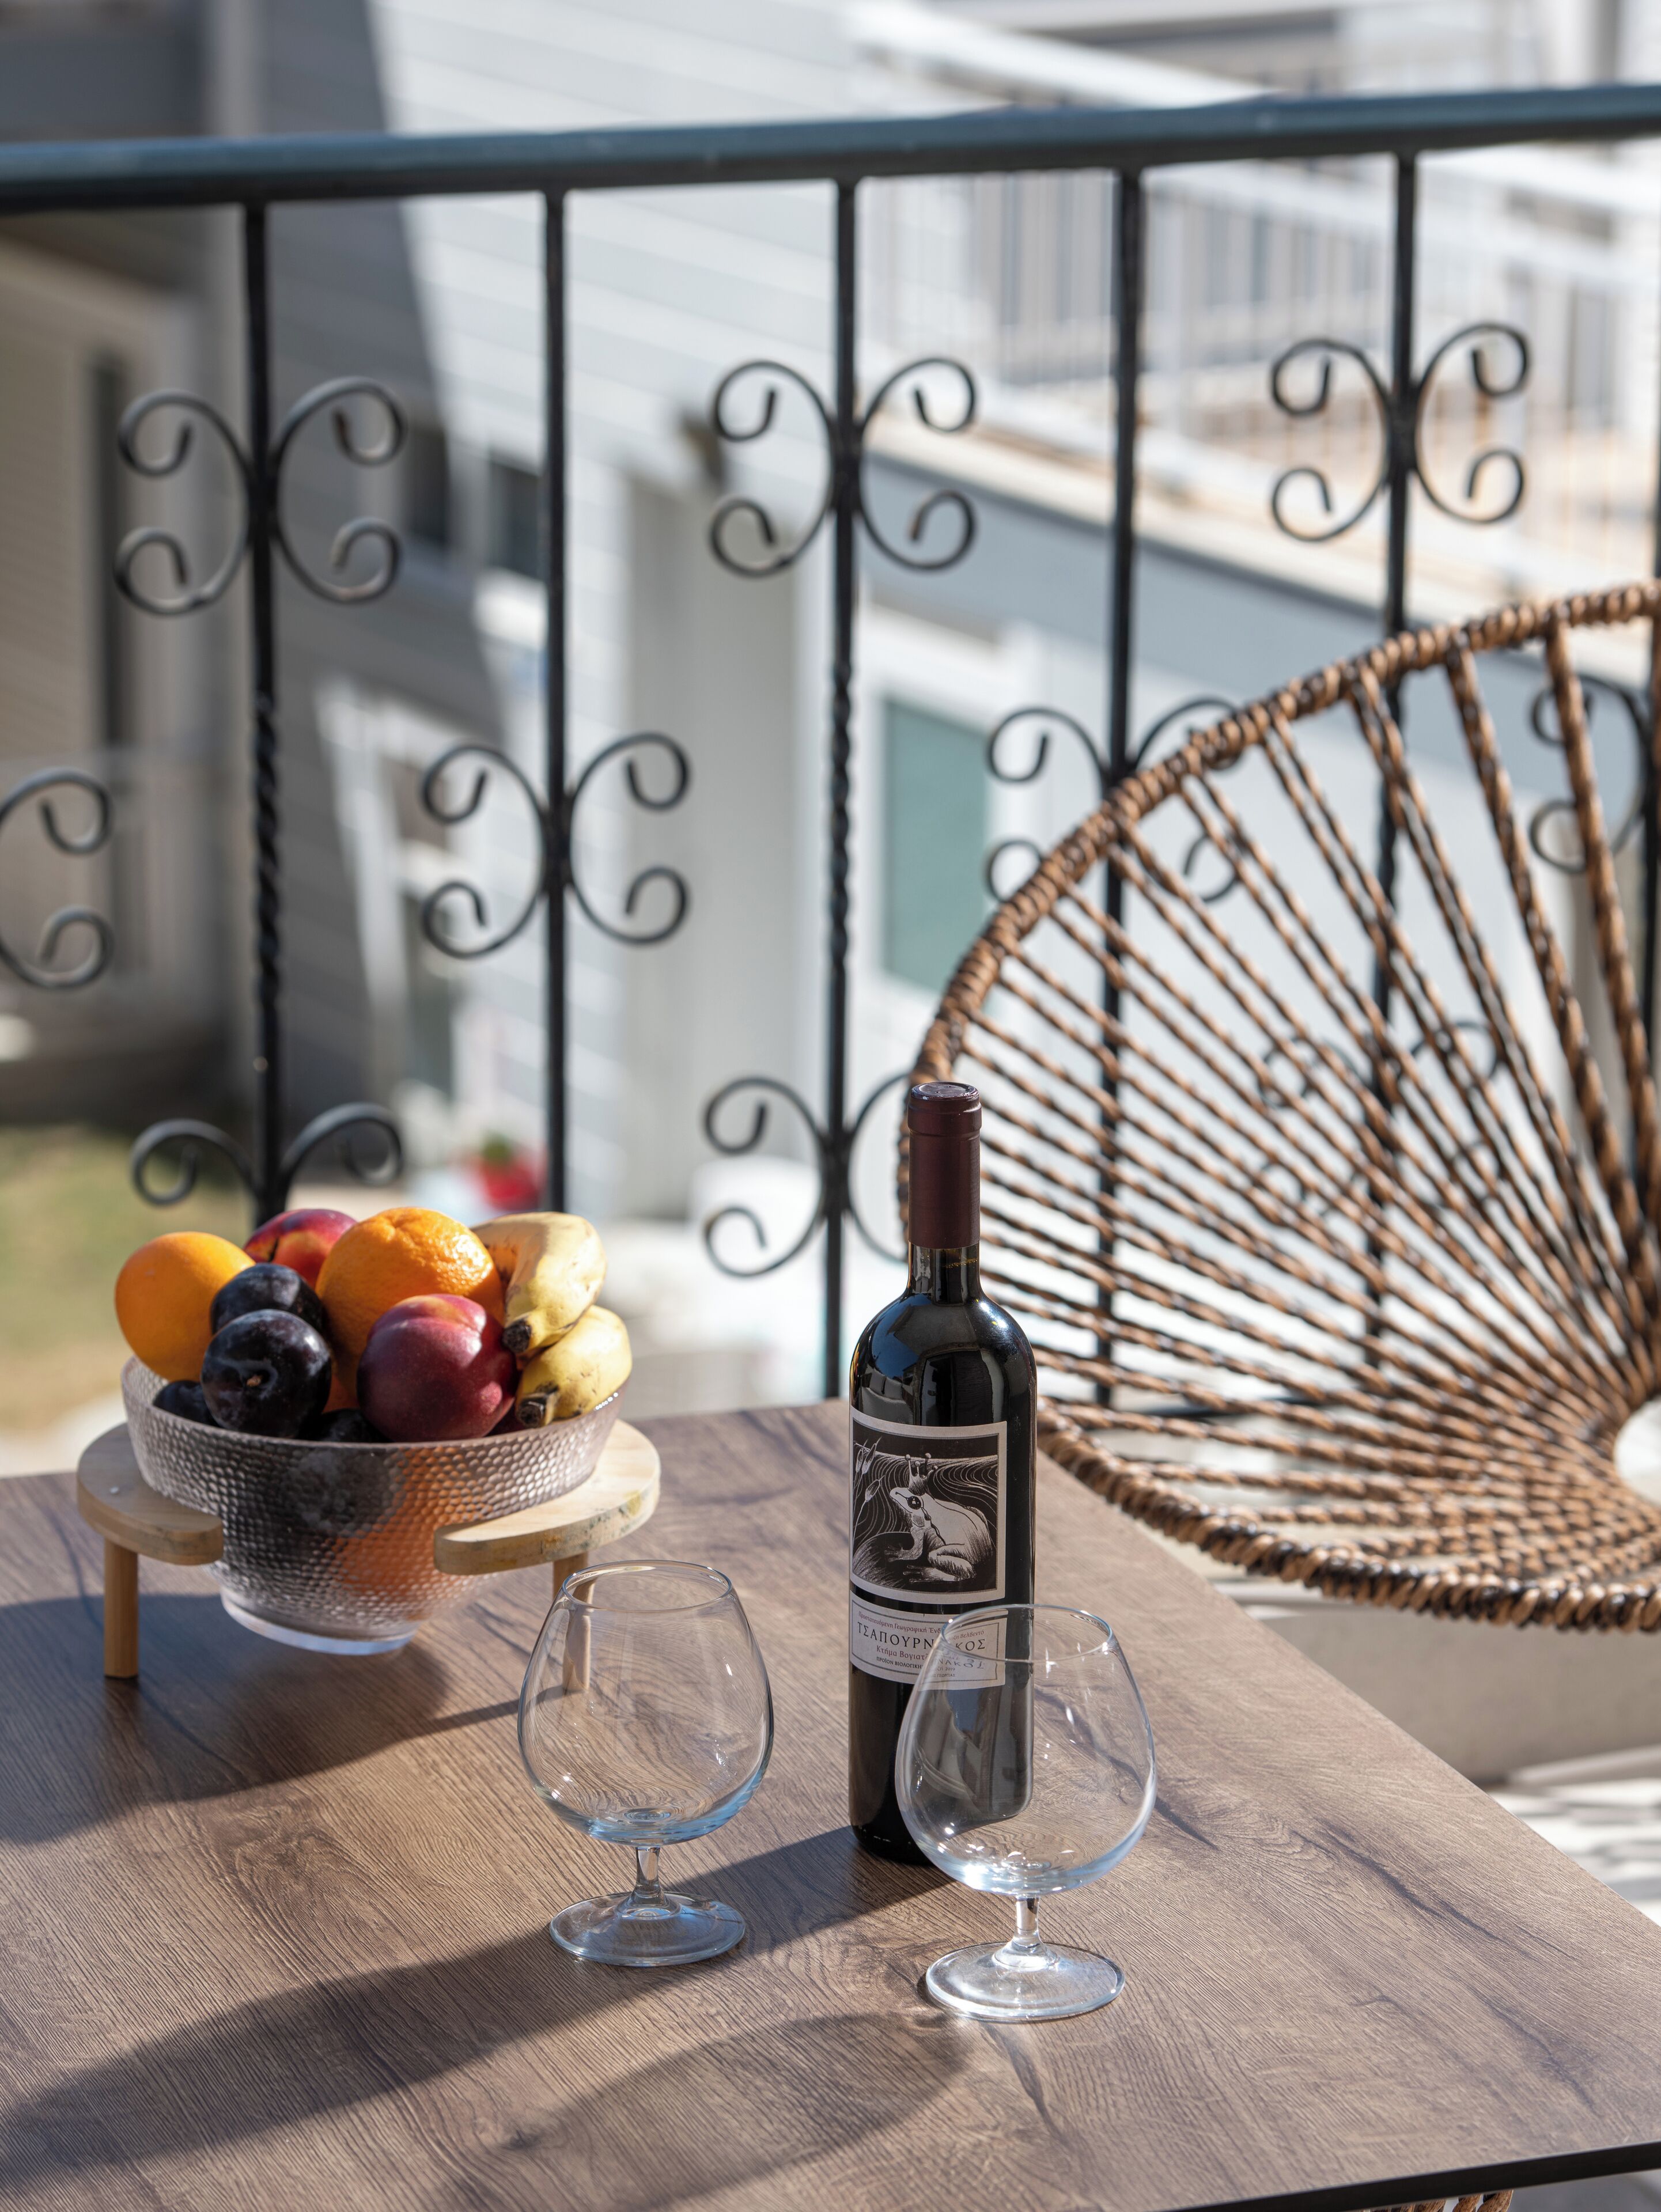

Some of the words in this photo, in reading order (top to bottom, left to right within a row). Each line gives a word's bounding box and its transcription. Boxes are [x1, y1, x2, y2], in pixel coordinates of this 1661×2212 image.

[894, 1623, 927, 1634] Γεωγραφική
[857, 1622, 986, 1651] ΤΣΑΠΟΥΡΝΚΟΣ
[876, 1645, 897, 1657] Κτήμα
[895, 1661, 923, 1669] ΒΙΟΛΟΓΙΚΗ
